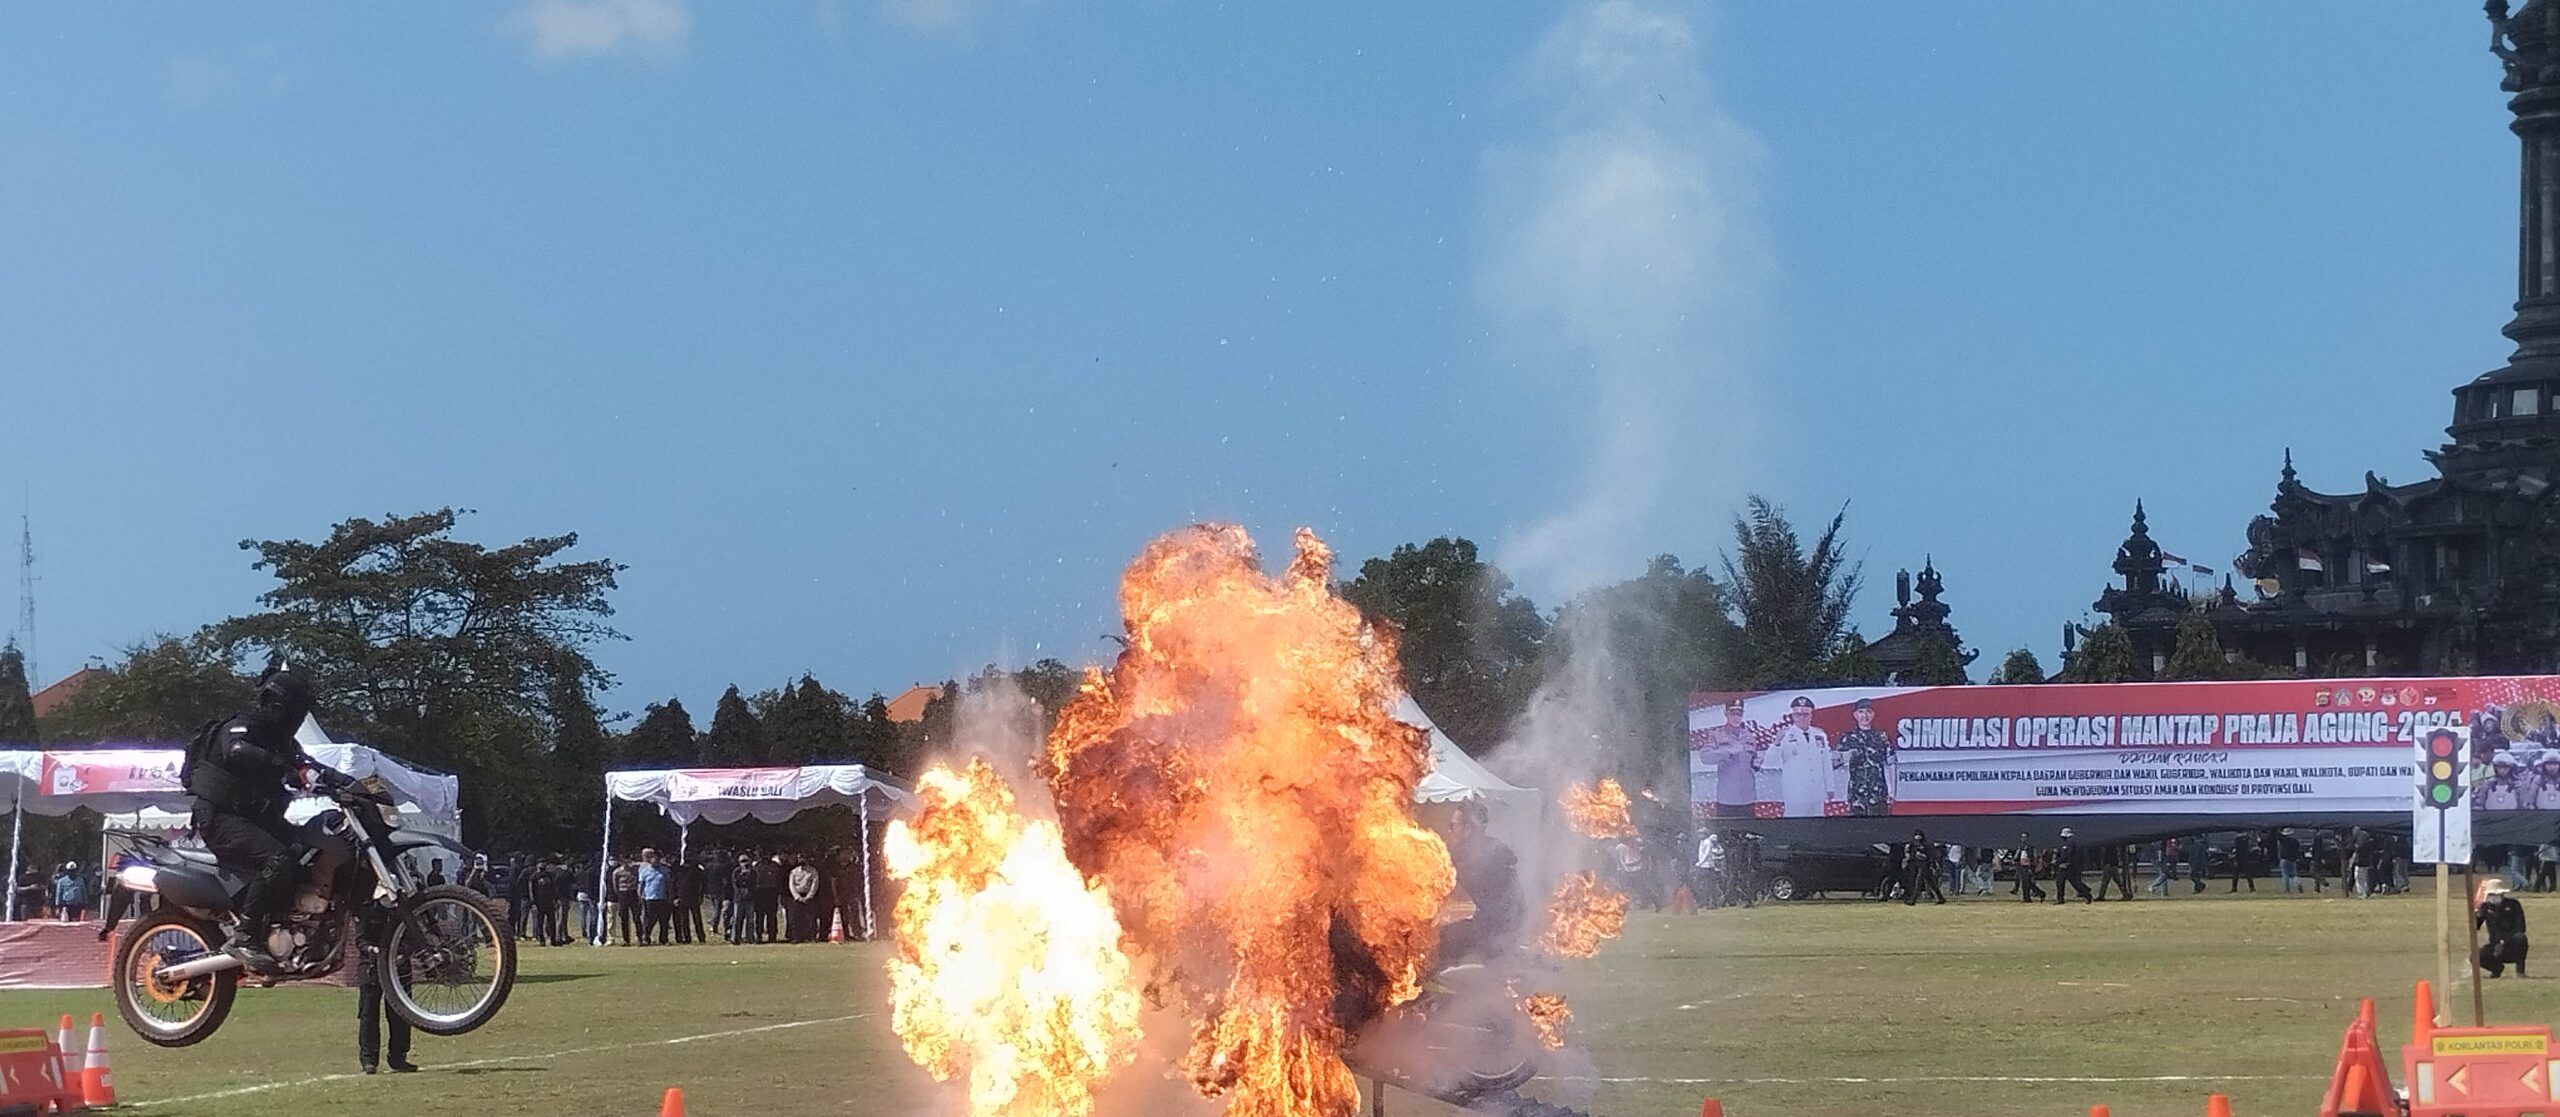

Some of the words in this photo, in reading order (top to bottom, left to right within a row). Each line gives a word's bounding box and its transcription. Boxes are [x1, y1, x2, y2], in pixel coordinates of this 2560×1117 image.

[1897, 717, 2010, 748] SIMULASI
[2015, 716, 2116, 747] OPERASI
[2120, 715, 2219, 745] MANTAP
[2224, 713, 2299, 744] PRAJA
[2119, 751, 2172, 764] DALAM
[2173, 752, 2229, 765] RANGKA
[1898, 771, 1955, 782] PENGAMANAN
[1956, 770, 1999, 782] PEMILIHAN
[2000, 770, 2032, 781] KEPALA
[2033, 769, 2067, 781] DAERAH
[2068, 769, 2112, 780] GUBERNUR
[2114, 769, 2131, 779] DAN
[2132, 769, 2159, 779] WAKIL
[2210, 768, 2251, 778] WALIKOTA
[2253, 768, 2271, 779] DAN
[2273, 768, 2300, 778] WAKIL
[2348, 767, 2378, 777] BUPATI
[2380, 766, 2398, 777] DAN
[2399, 766, 2415, 777] WA
[2036, 786, 2058, 796] GUNA
[2120, 784, 2153, 795] SITUASI
[2154, 784, 2179, 795] AMAN
[2180, 784, 2197, 794] DAN
[2198, 784, 2239, 794] KONDUSIF
[2241, 784, 2250, 794] DI
[2251, 783, 2291, 794] PROVINSI
[2448, 1041, 2502, 1051] KORLANTAS
[2505, 1040, 2532, 1049] POLRI
